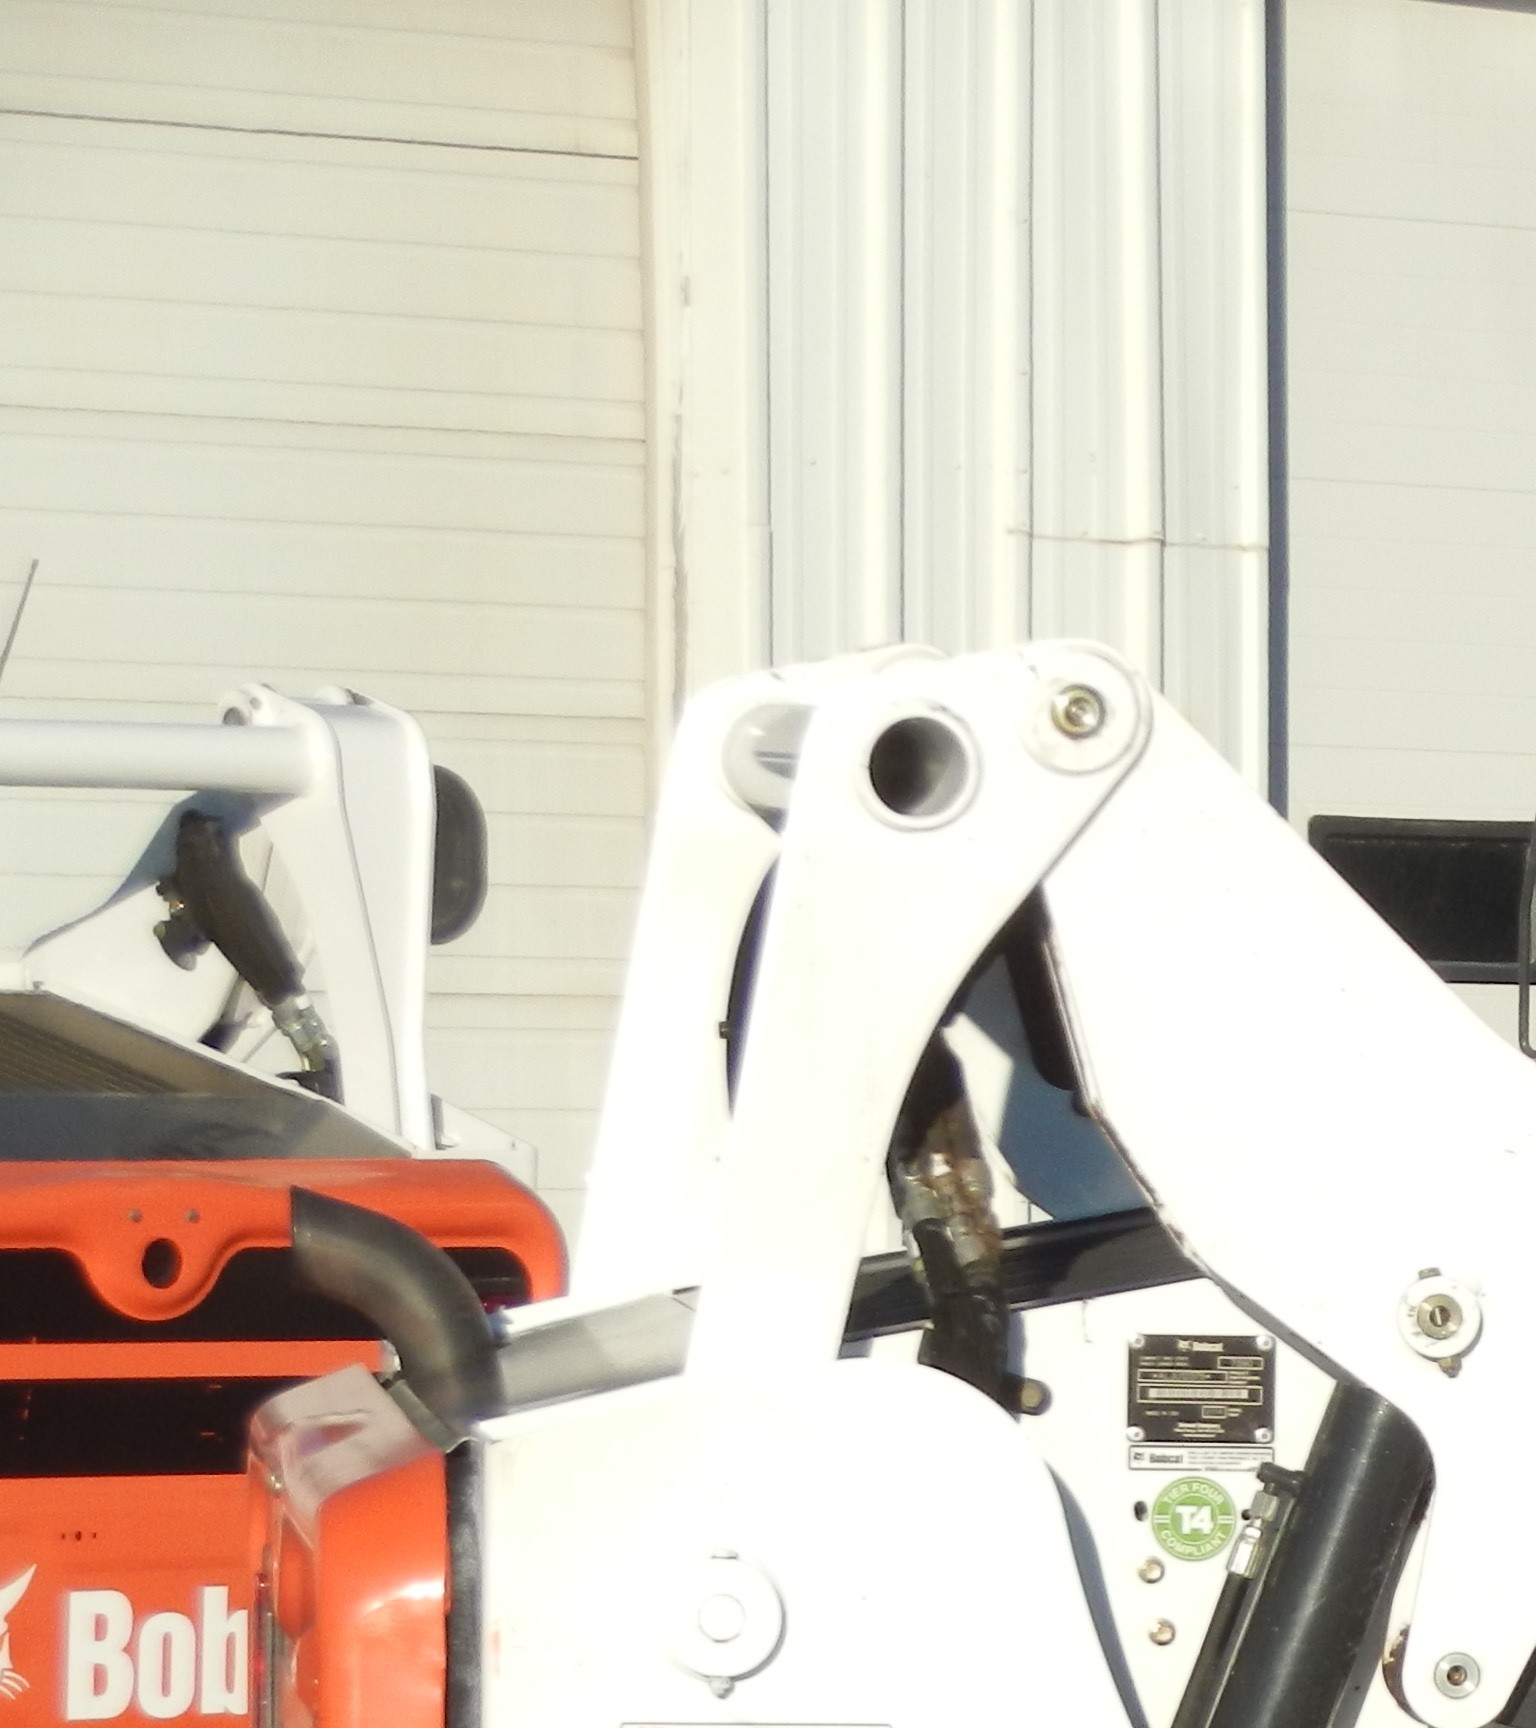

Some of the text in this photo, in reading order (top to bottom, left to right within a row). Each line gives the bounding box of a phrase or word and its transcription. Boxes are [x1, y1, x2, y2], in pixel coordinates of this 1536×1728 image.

[1163, 1483, 1225, 1505] TIER FOUR
[1175, 1505, 1214, 1534] T4
[1161, 1530, 1226, 1555] COMPLIANT
